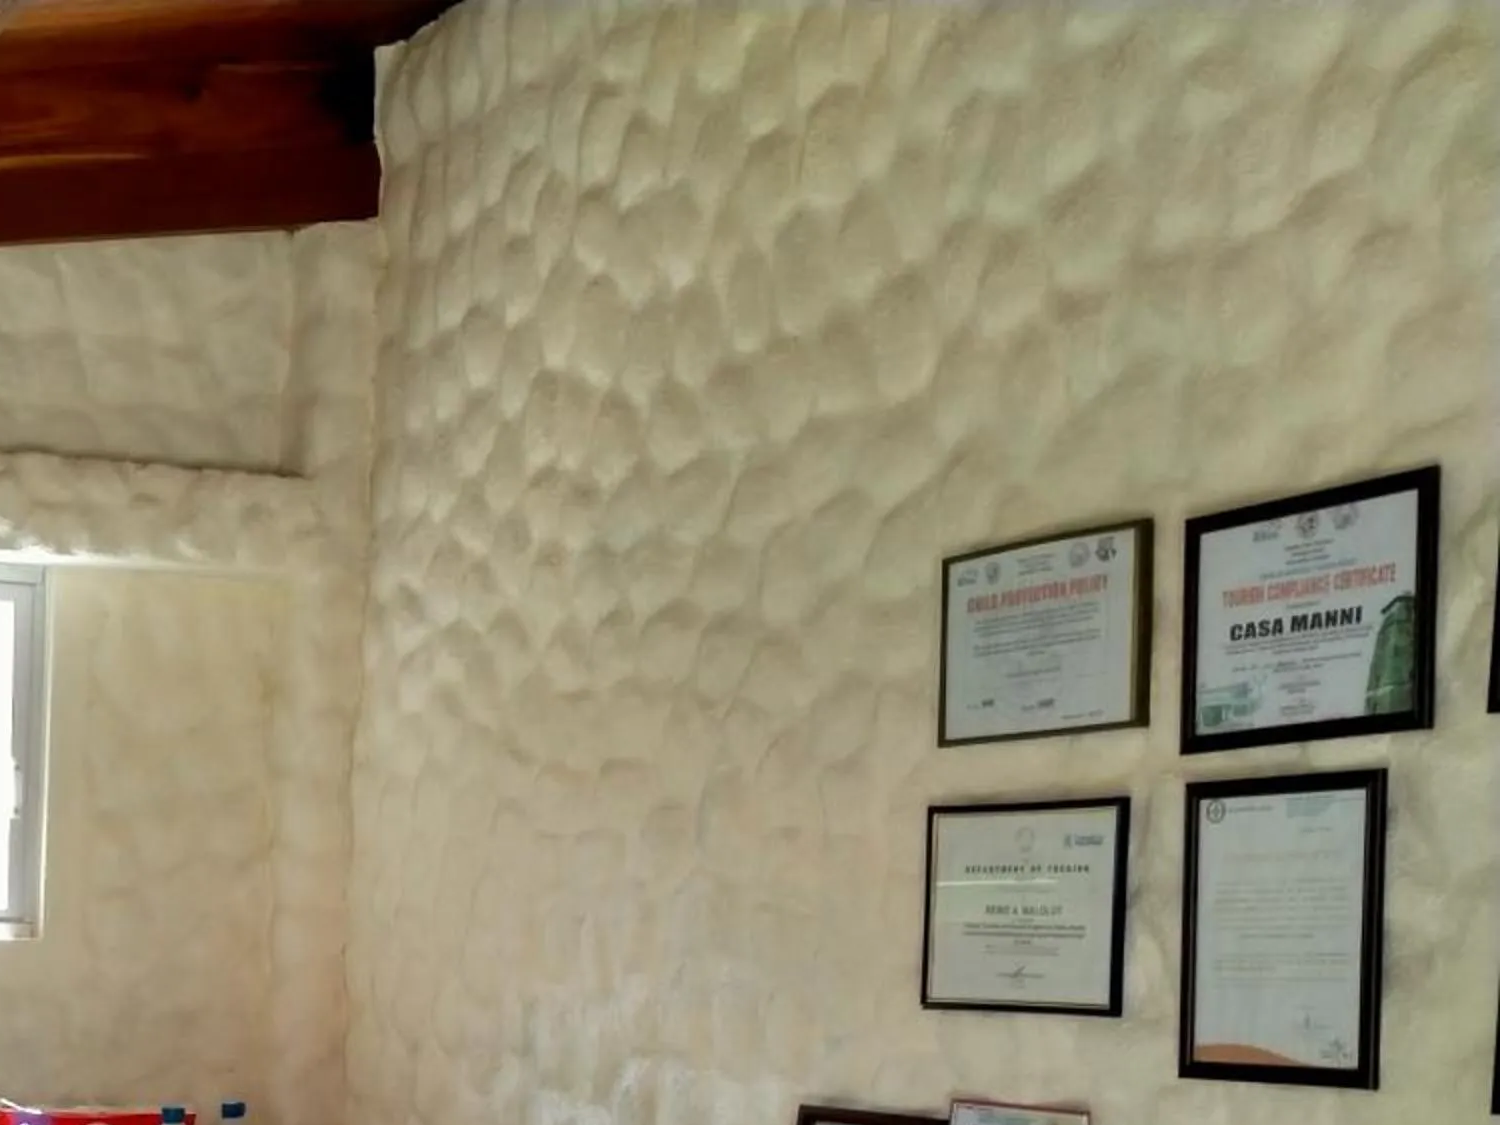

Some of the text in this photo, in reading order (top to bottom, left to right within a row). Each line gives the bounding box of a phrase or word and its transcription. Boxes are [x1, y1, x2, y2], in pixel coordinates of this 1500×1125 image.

[1333, 562, 1396, 591] CERTIFICATE
[1230, 605, 1363, 641] CASA MANNI
